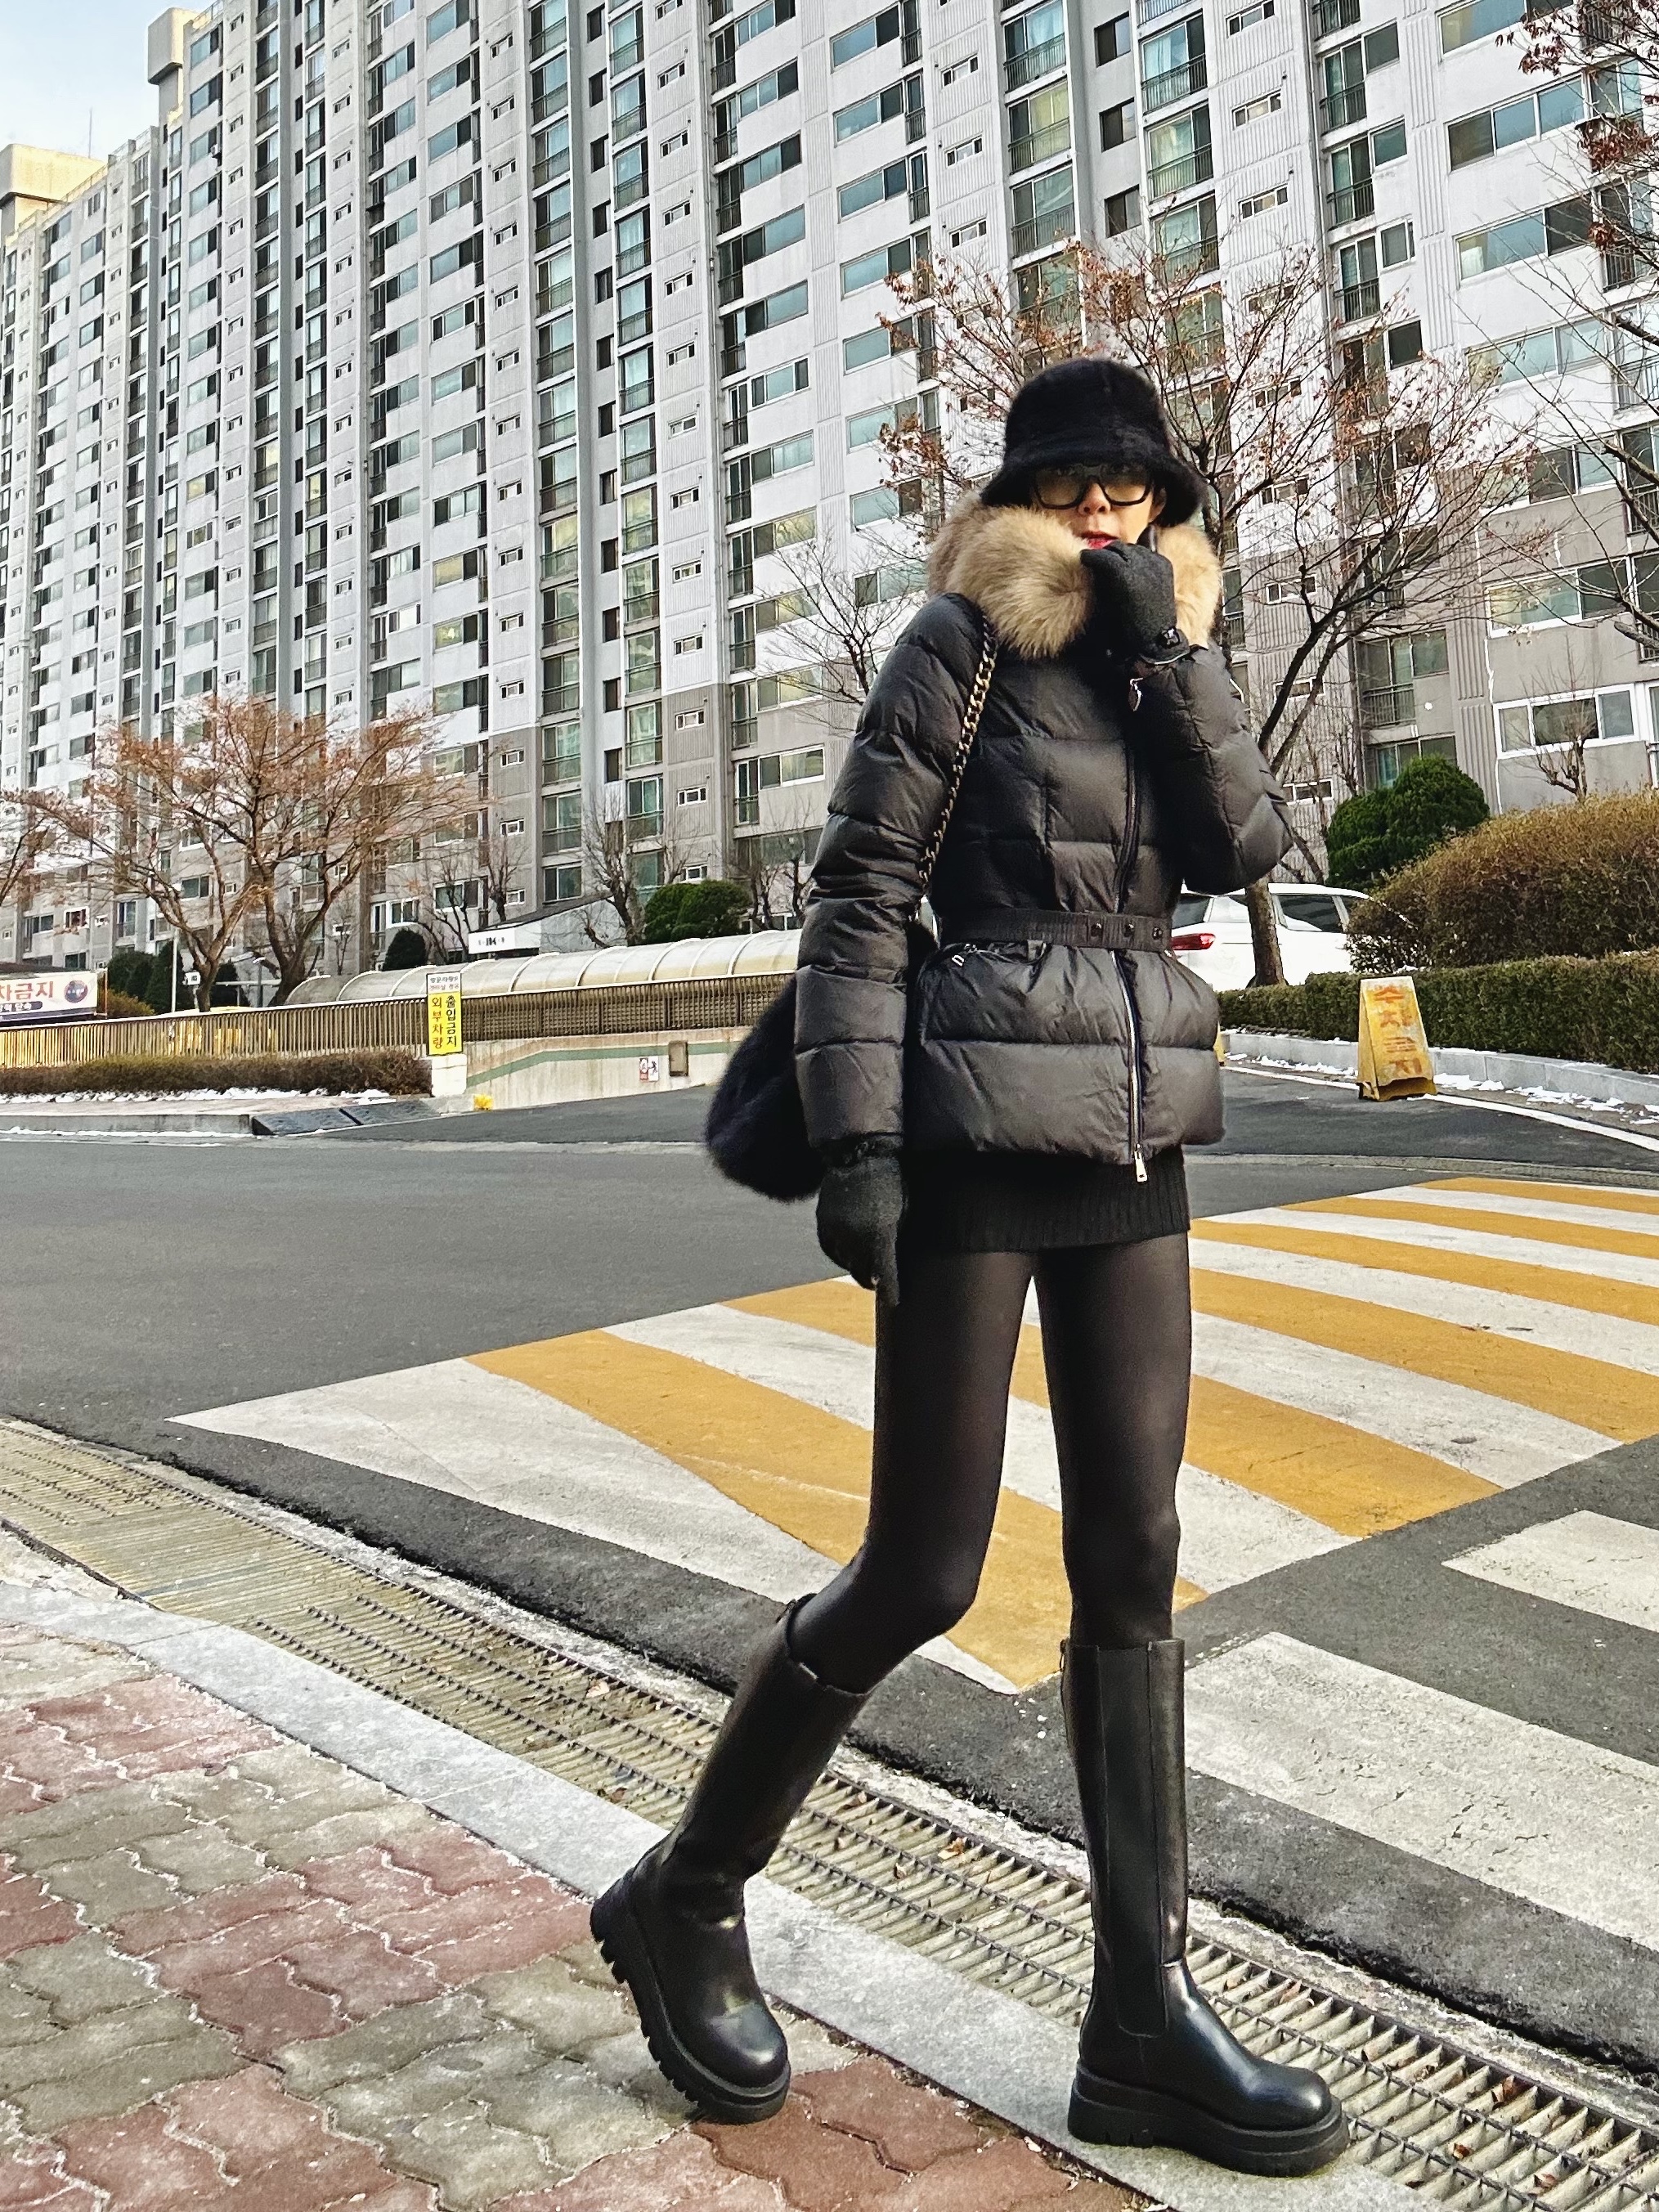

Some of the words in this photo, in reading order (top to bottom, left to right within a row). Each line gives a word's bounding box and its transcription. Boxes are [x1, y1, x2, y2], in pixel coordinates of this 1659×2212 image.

[432, 997, 443, 1049] 외부차량
[446, 995, 456, 1047] 출입금지
[1373, 985, 1423, 1075] 주차금지
